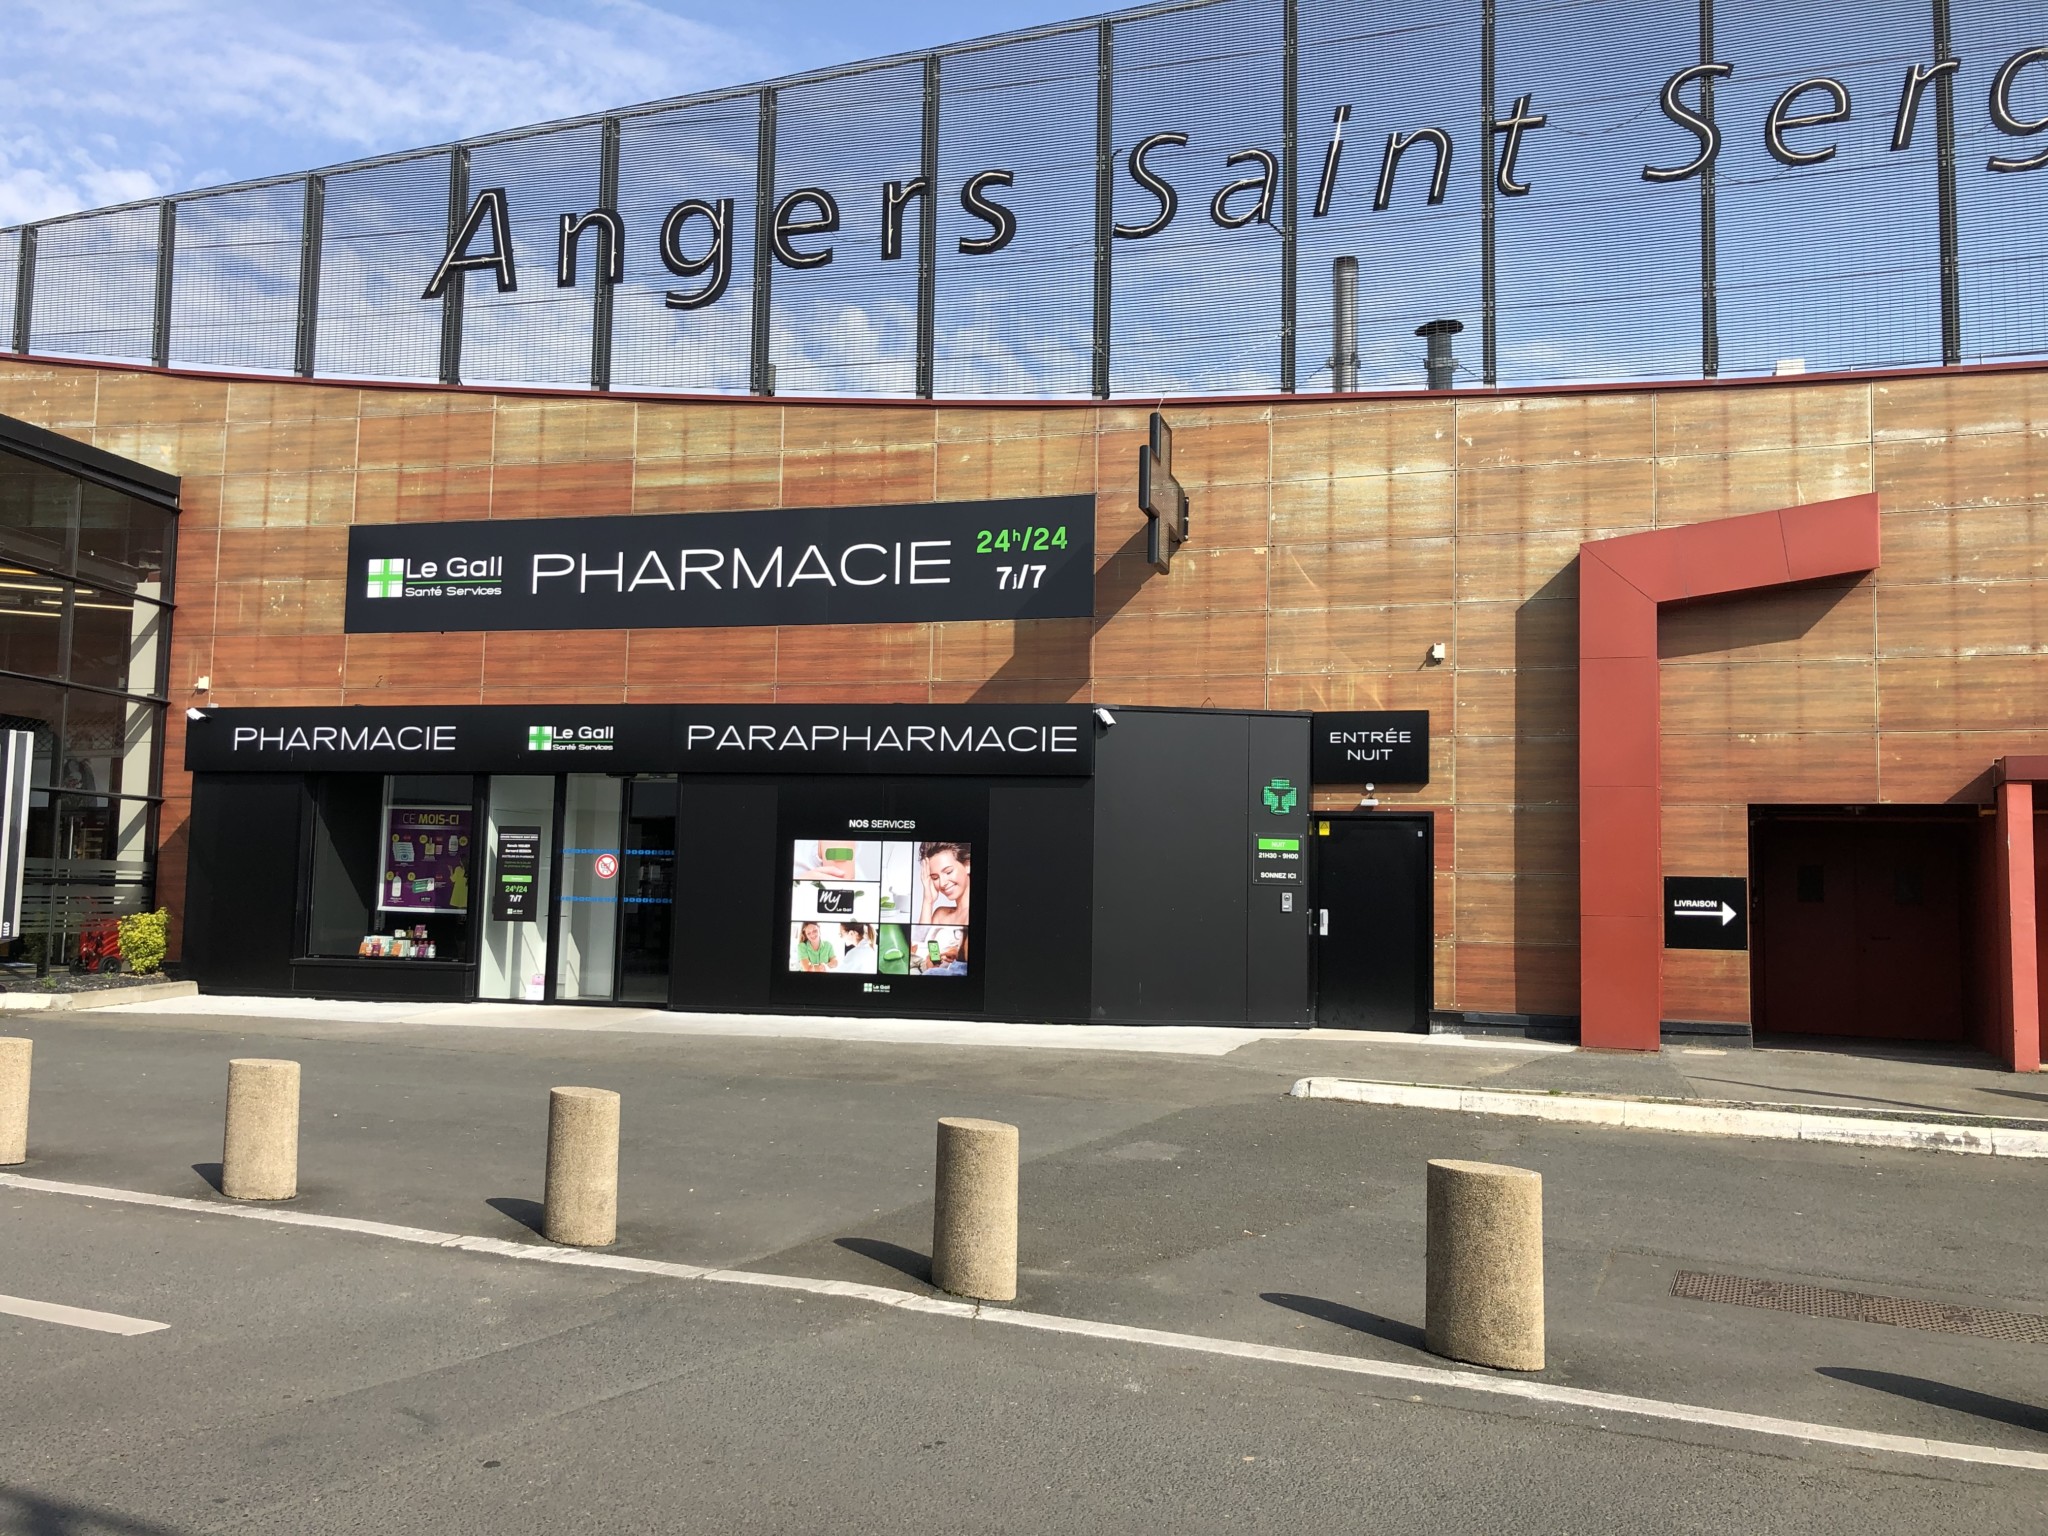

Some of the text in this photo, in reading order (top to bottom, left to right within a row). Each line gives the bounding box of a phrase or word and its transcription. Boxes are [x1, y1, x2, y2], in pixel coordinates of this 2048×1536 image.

[421, 169, 1017, 310] Angers
[1112, 92, 1547, 239] Saint
[976, 526, 1068, 554] 24h/24
[406, 556, 502, 579] Le Gall
[532, 540, 951, 594] PHARMACIE
[996, 564, 1047, 590] 7j/7
[405, 586, 502, 597] Santé Services
[233, 725, 457, 751] PHARMACIE
[553, 726, 614, 739] Le Gall
[687, 725, 1078, 752] PARAPHARMACIE
[1329, 728, 1411, 744] ENTRÉE
[552, 743, 577, 751] Santé
[1347, 749, 1393, 761] NUIT
[402, 813, 460, 825] CE MOIS-CI
[849, 819, 916, 829] NOS SERVICES
[1260, 871, 1287, 879] SONNEZ
[819, 890, 842, 912] My
